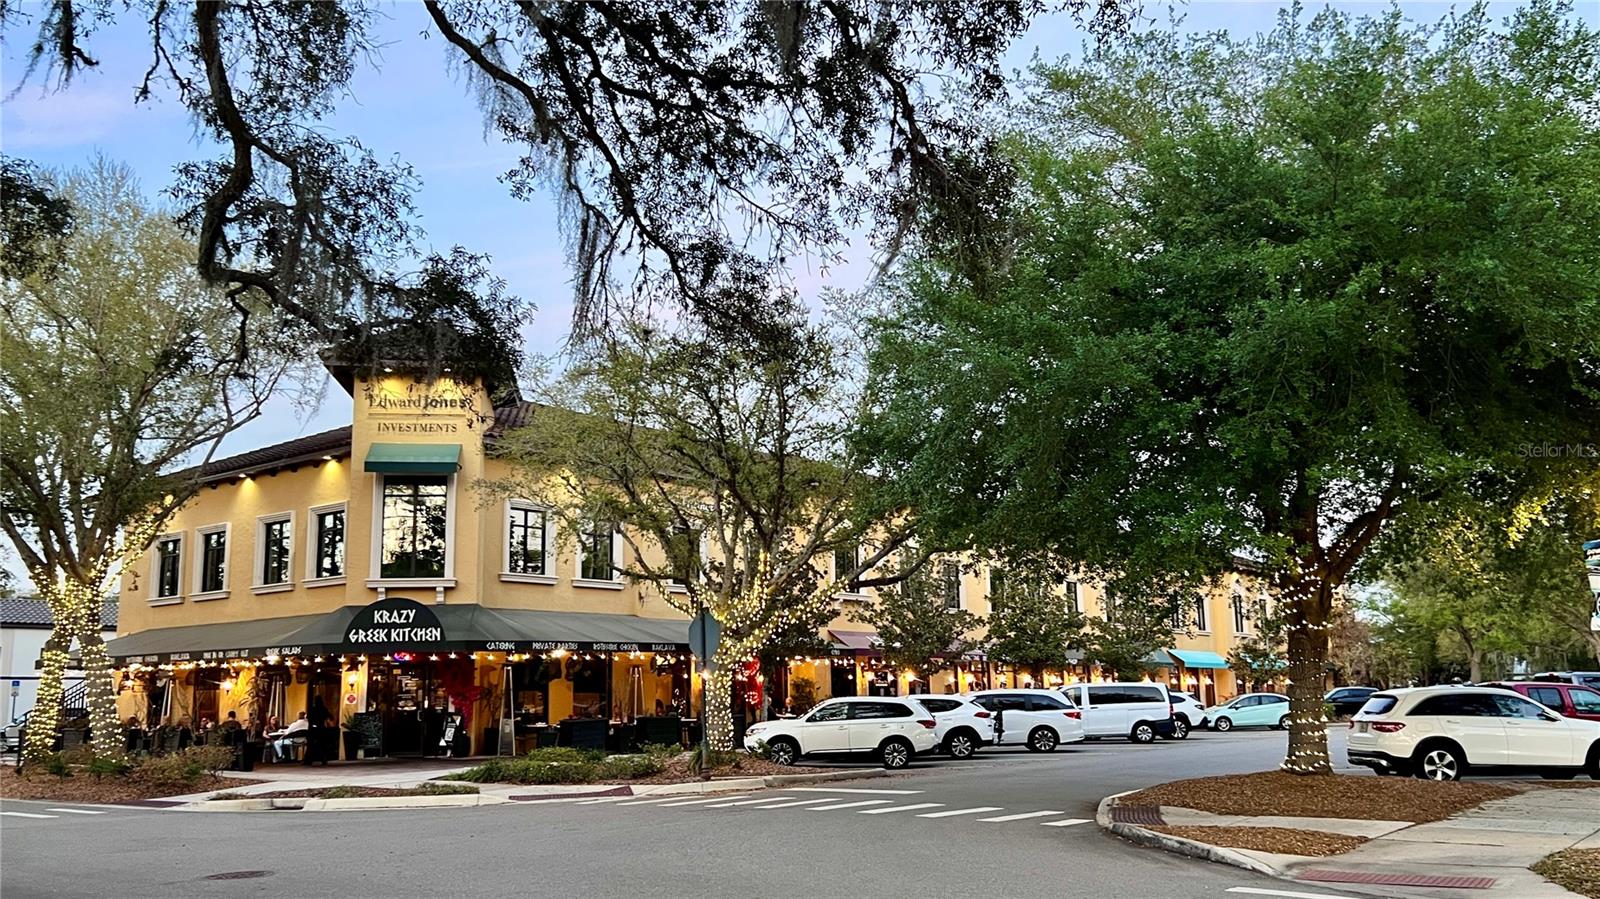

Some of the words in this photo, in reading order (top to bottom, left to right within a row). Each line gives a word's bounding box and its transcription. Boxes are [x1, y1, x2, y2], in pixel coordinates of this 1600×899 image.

[377, 422, 458, 433] INVESTMENTS
[373, 609, 416, 624] KRAZY
[348, 628, 388, 643] GREEK
[390, 627, 441, 642] KITCHEN
[532, 642, 556, 650] PRIVATE
